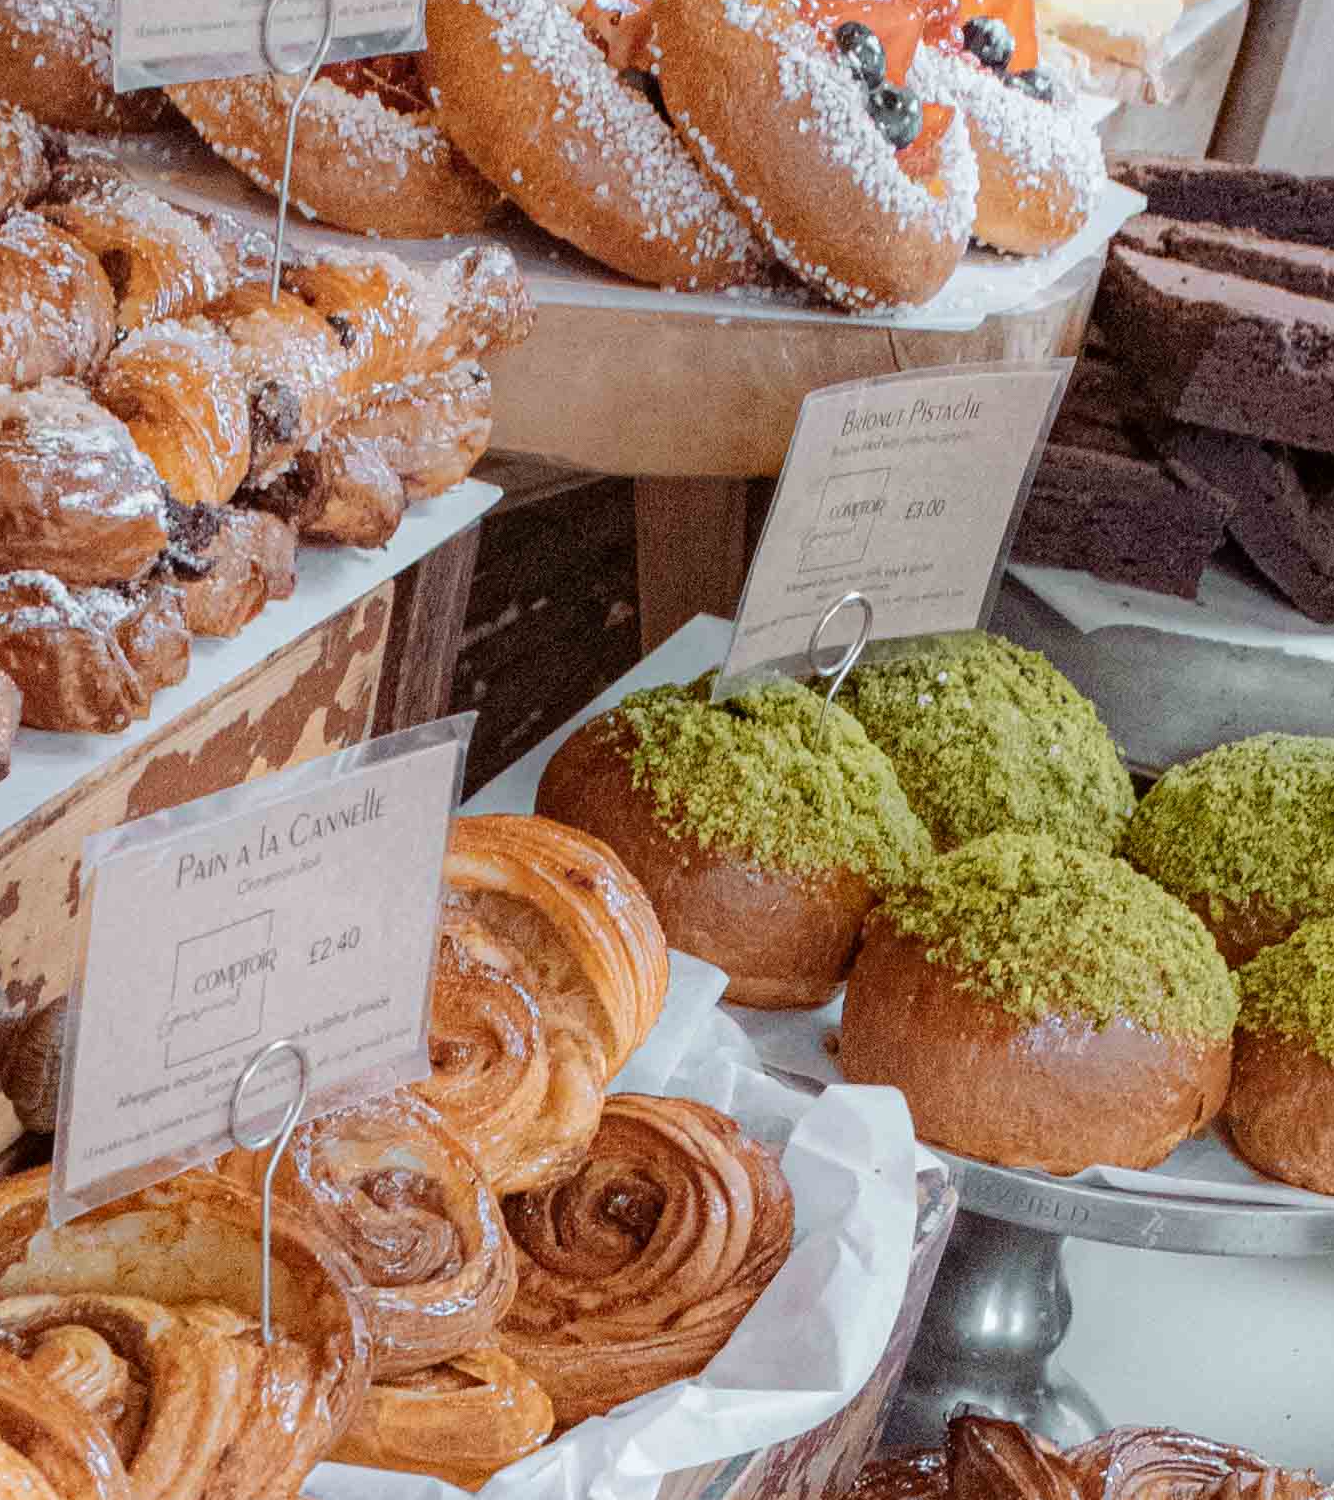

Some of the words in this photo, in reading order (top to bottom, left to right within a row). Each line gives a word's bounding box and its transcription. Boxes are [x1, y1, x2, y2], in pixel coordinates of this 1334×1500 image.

[905, 498, 946, 520] £3.00
[307, 926, 361, 966] £2.40
[193, 948, 278, 995] COMPTOIR
